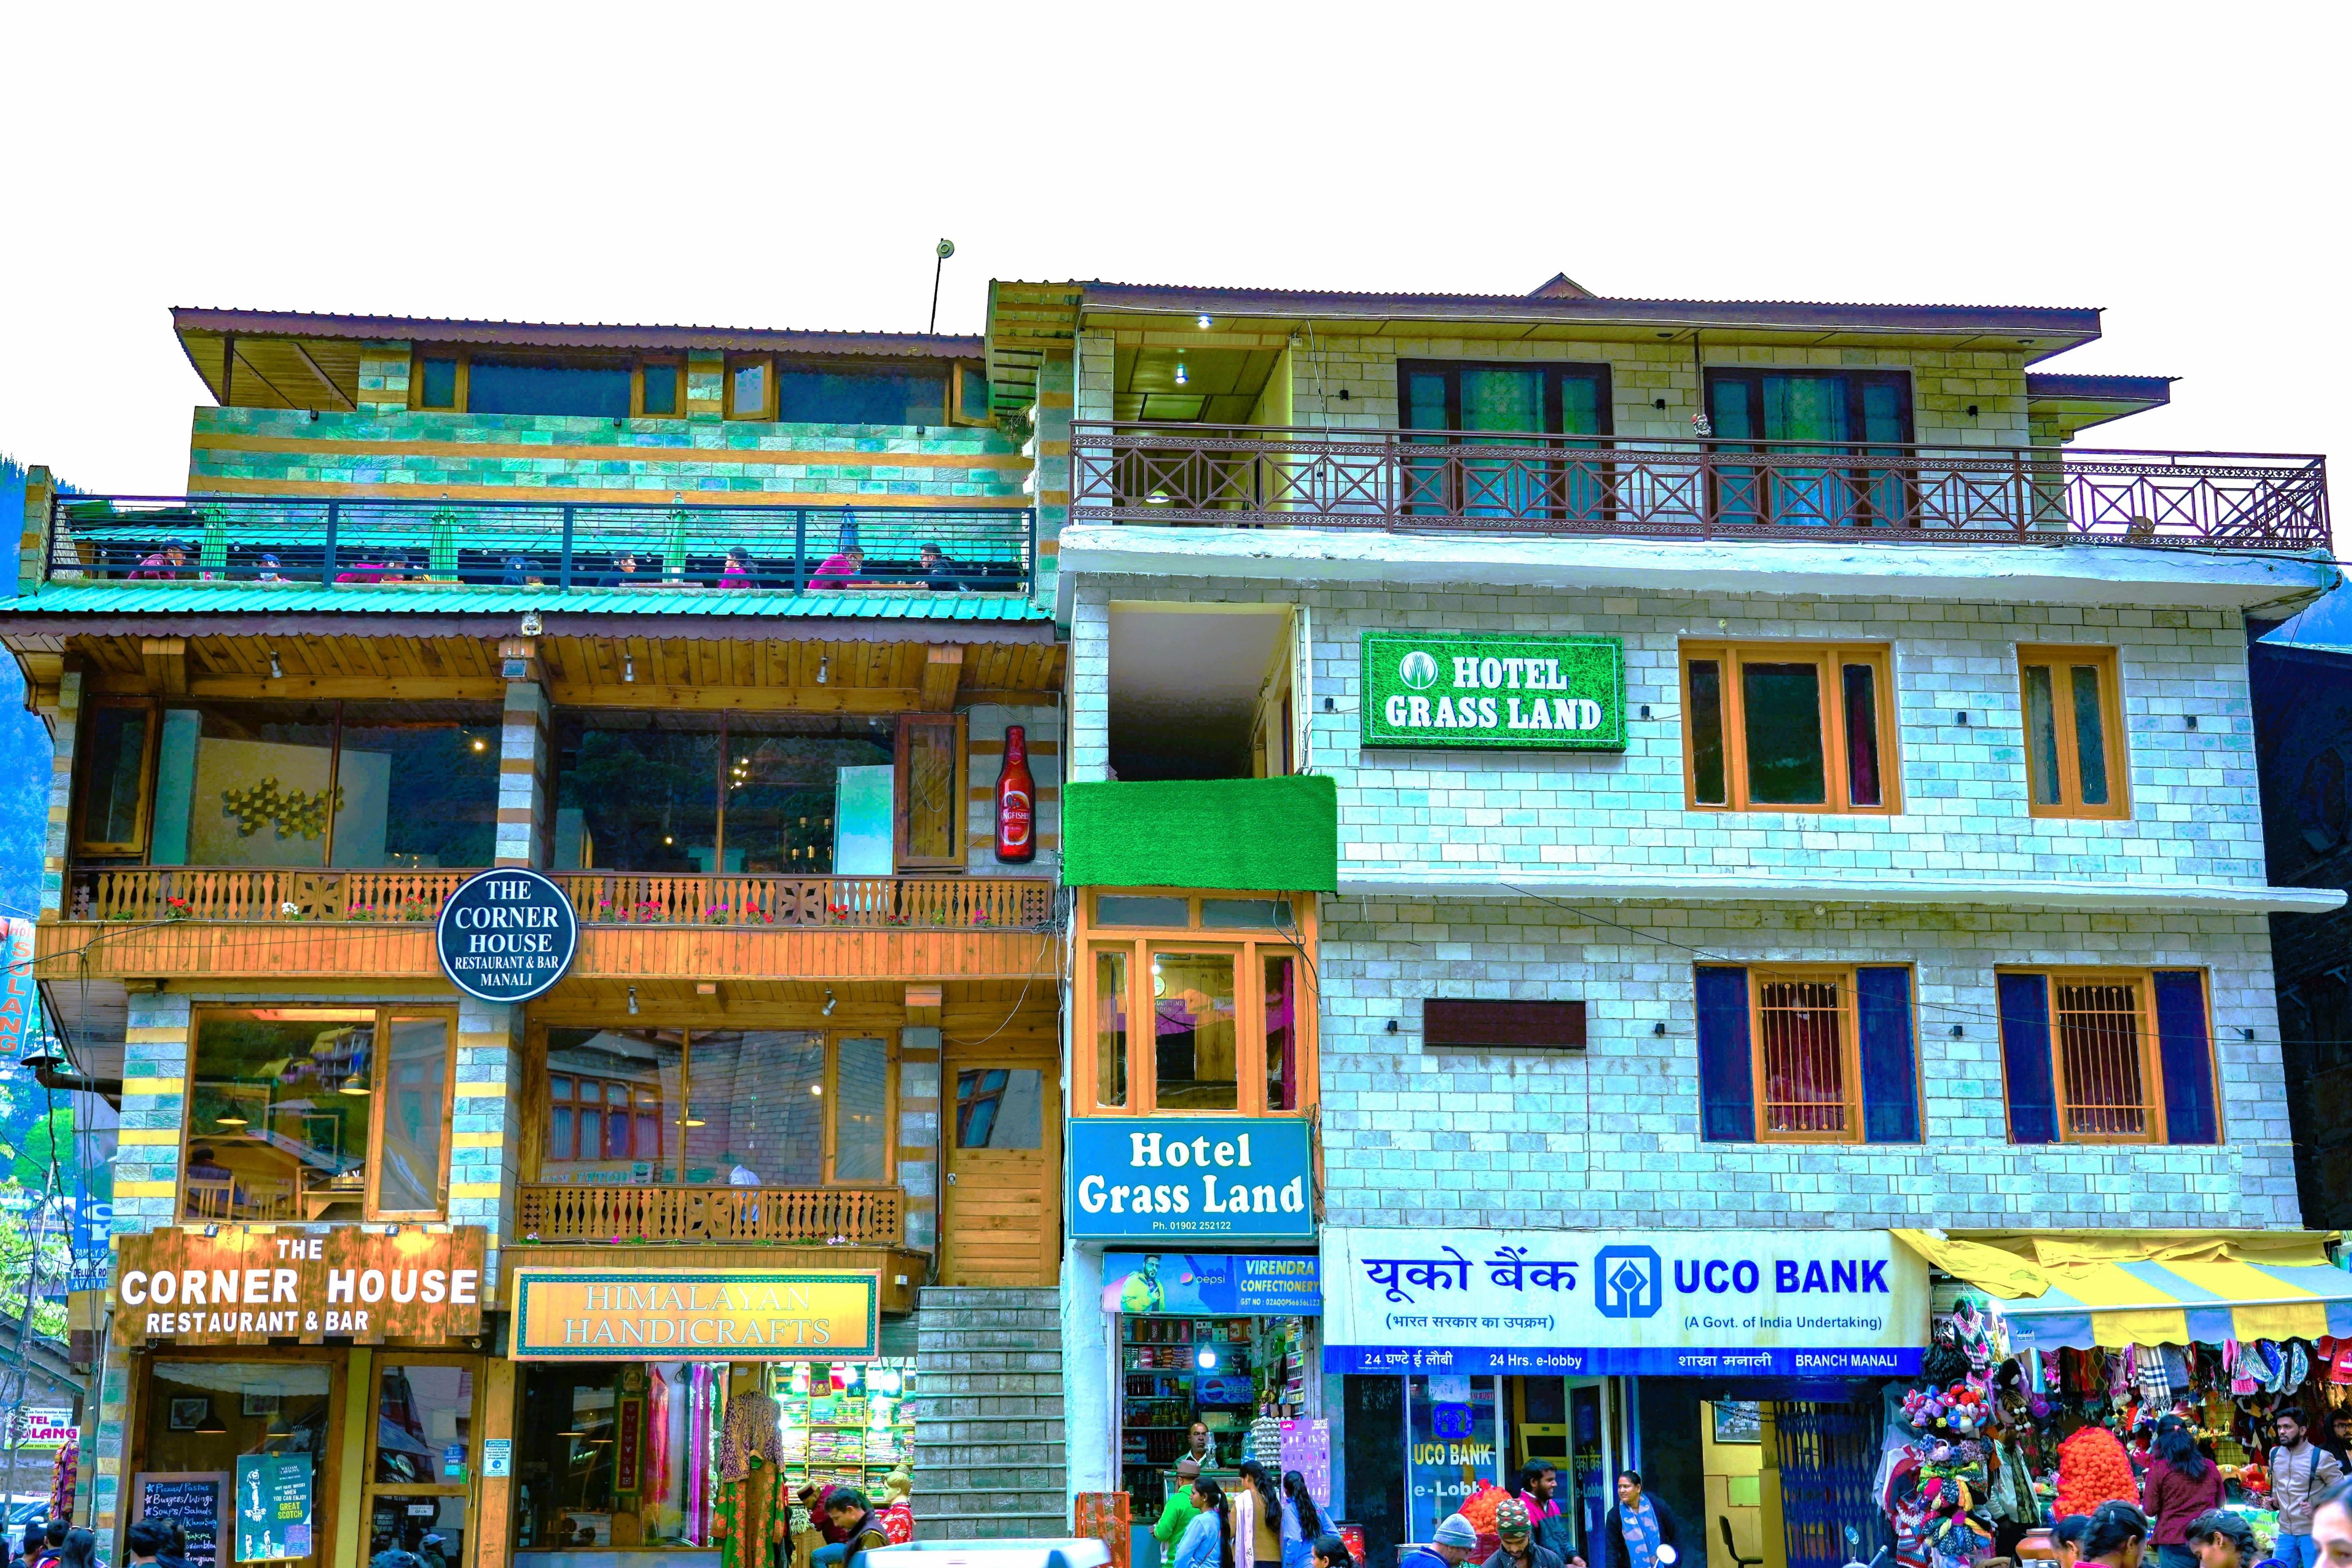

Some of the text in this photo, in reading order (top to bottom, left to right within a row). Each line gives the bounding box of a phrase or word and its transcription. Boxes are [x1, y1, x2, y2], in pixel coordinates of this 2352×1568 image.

[1452, 656, 1568, 690] HOTEL
[1385, 695, 1602, 730] GRASS LAND
[486, 880, 531, 900] THE
[455, 906, 559, 928] CORNER
[468, 934, 552, 953] HOUSE
[455, 956, 559, 969] RESTAURANT & BAR
[480, 973, 532, 986] MANALI
[1130, 1132, 1252, 1167] Hotel
[1078, 1174, 1305, 1213] Grass Land
[1199, 1221, 1231, 1229] 252122
[277, 1239, 323, 1259] THE
[98, 1268, 107, 1277] RO
[1246, 1260, 1315, 1275] VIRENDRA
[1360, 1245, 1580, 1304] यूको बैंक
[1674, 1259, 1889, 1293] UCO BANK
[121, 1269, 477, 1305] CORNER HOUSE
[1196, 1275, 1225, 1285] pepsi
[1240, 1280, 1320, 1292] CONFECTIONERY
[584, 1286, 812, 1311] HIMALAYAN
[146, 1311, 368, 1333] RESTAURANT & BAR
[1386, 1313, 1555, 1331] (भारत सरकार का उपक्रम)
[1685, 1316, 1882, 1331] (A Govt. of India Undertaking)
[562, 1319, 831, 1344] HANDICRAFTS
[1365, 1350, 1453, 1367] 24 घण्टे ई लौबी
[1490, 1354, 1582, 1369] 24 Hrs. e-lobby
[1678, 1352, 1772, 1366] शाखा मनाली
[1796, 1355, 1897, 1366] BRANCH MANALI
[1226, 1385, 1254, 1394] PEPS
[1414, 1444, 1491, 1465] UCO BANK
[1414, 1481, 1484, 1496] e-Lobb
[278, 1510, 303, 1519] SCOTCH
[280, 1502, 301, 1510] GREAT
